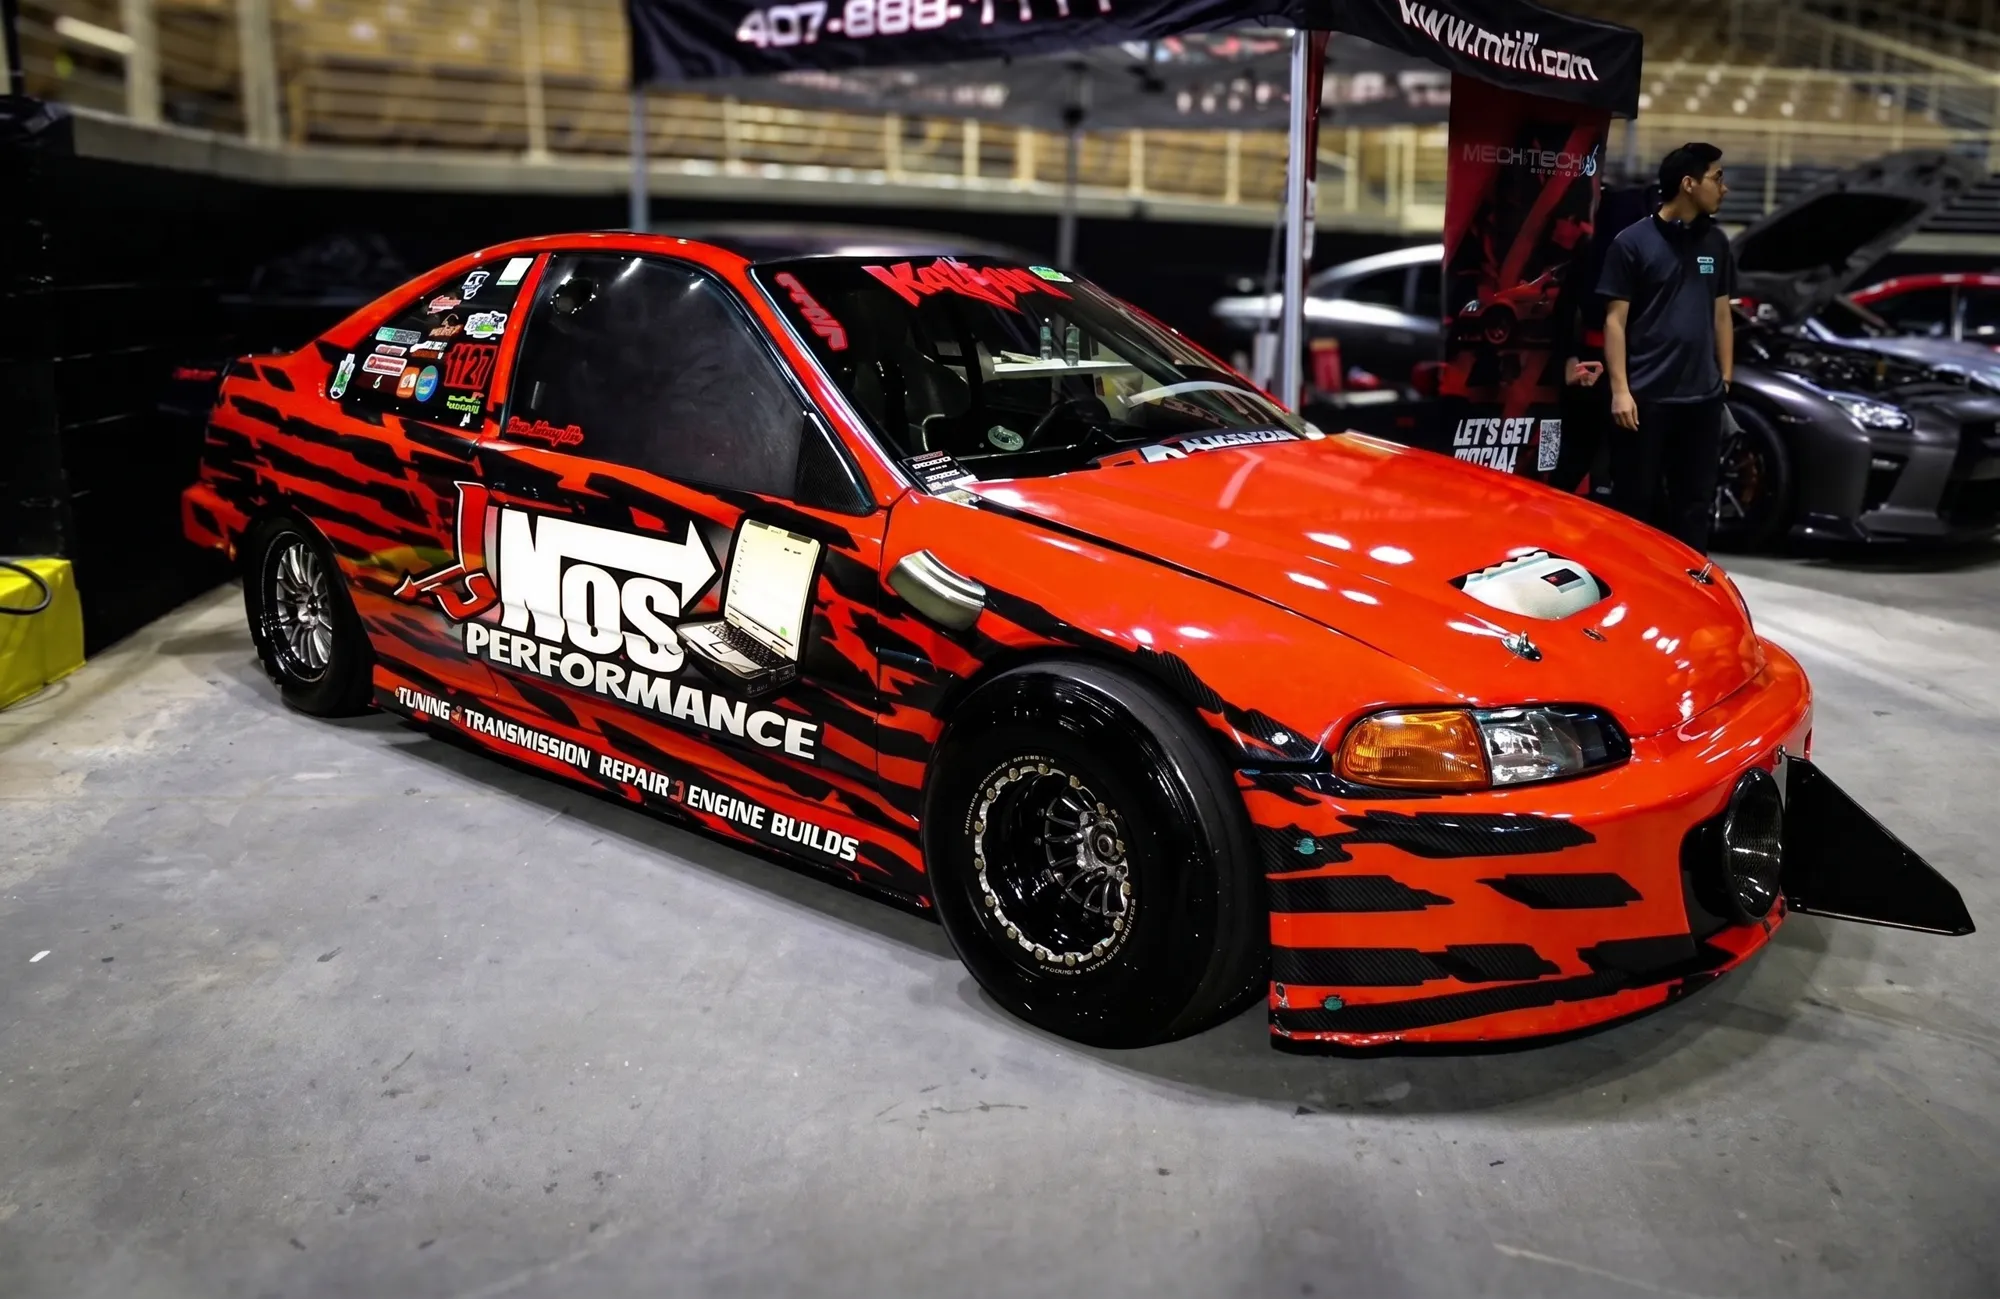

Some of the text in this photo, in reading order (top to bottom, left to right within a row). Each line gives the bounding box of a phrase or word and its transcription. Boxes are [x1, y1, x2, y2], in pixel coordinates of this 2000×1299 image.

[1453, 417, 1535, 446] LET'S GET
[500, 508, 688, 673] NOS
[466, 622, 818, 760] PERFORMANCE
[398, 686, 859, 862] TUNING TRANSMISSION REPAIR ENGINE BUILDS
